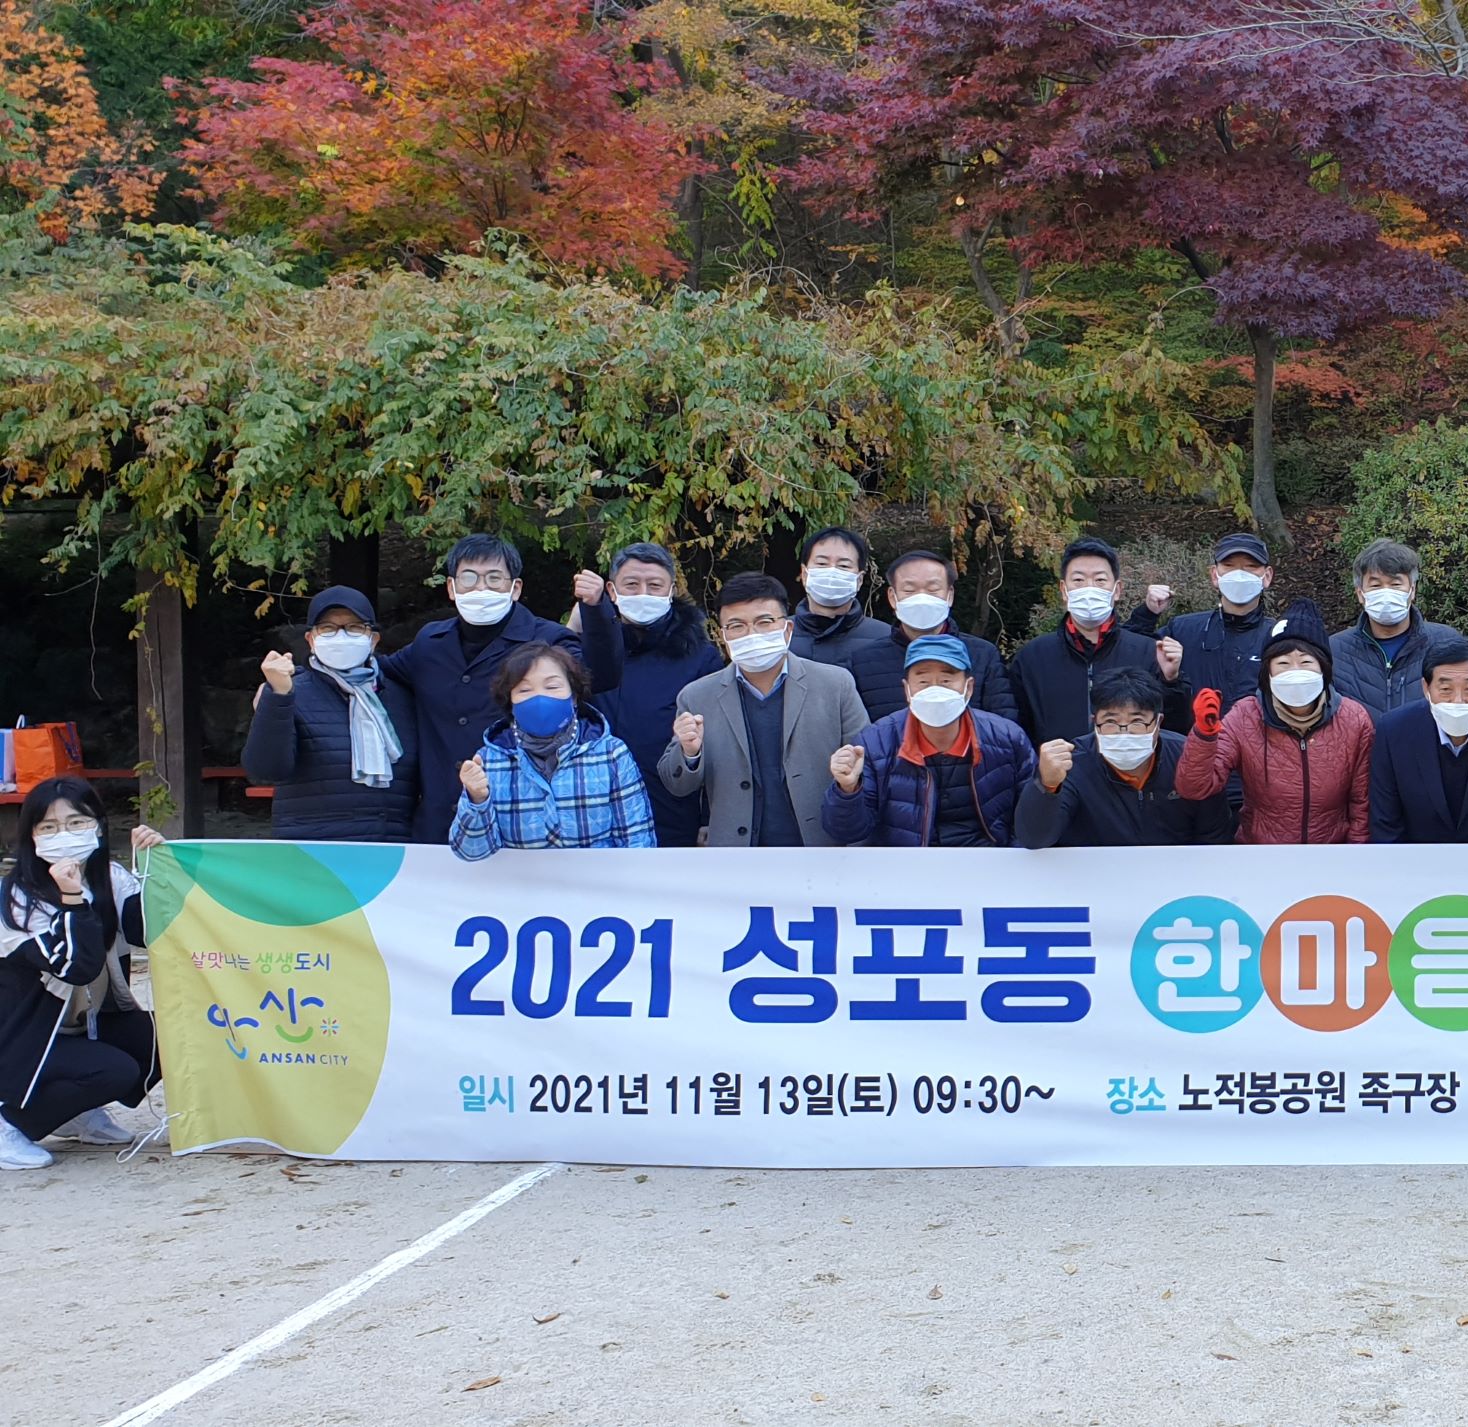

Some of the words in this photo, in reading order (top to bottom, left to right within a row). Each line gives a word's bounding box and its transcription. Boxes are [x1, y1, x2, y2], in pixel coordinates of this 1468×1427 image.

[191, 951, 251, 970] 살맛나는
[255, 951, 331, 974] 생생도시
[451, 915, 674, 1020] 2021
[722, 905, 1097, 1024] 성포동
[258, 1052, 316, 1065] ANSAN
[319, 1054, 349, 1067] CITY
[459, 1075, 515, 1113] 일시
[529, 1073, 649, 1115] 2021년
[665, 1072, 742, 1116] 11월
[758, 1072, 898, 1117] 13일(토)
[913, 1075, 1056, 1115] 09:30~
[1106, 1076, 1167, 1115] 장소
[1178, 1070, 1346, 1115] 노적봉공원
[1358, 1071, 1461, 1114] 족구장
